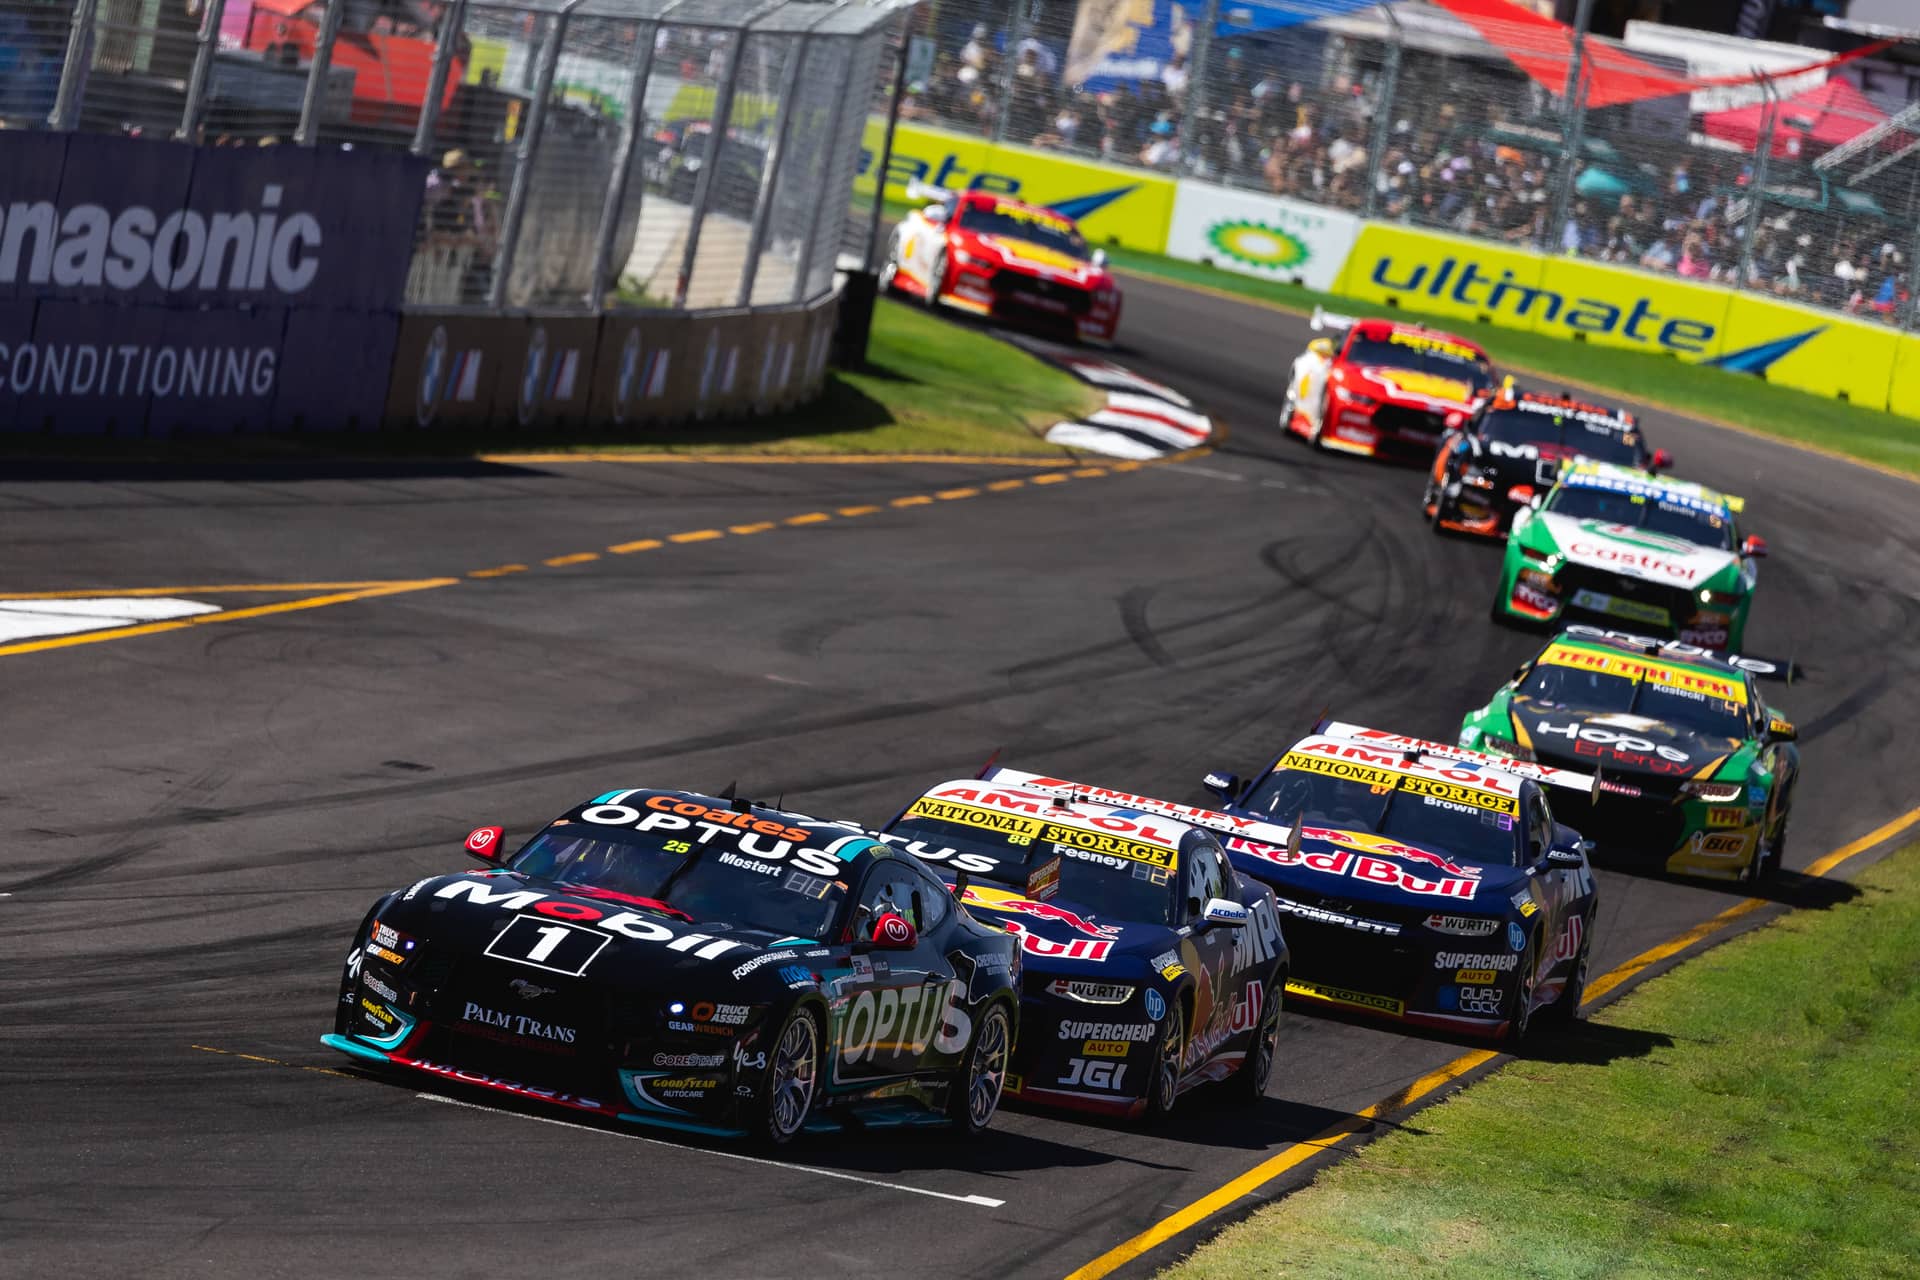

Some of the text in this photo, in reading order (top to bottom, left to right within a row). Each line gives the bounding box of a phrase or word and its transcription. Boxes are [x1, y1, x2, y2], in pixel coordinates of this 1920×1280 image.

[0, 184, 322, 292] nasonic
[1371, 256, 1715, 352] ultimate
[1570, 542, 1695, 580] Castrol
[1390, 734, 1560, 776] AMPLIFY
[1537, 721, 1689, 762] Hope
[1300, 742, 1514, 795] AMPOL
[1574, 738, 1695, 775] Energy
[1284, 753, 1392, 786] NATIONAL
[1403, 775, 1511, 813] STORAGE
[646, 795, 812, 842] coates
[935, 787, 1175, 845] AMPOL
[1066, 782, 1257, 829] AMPLIFY
[1424, 795, 1478, 816] Brown
[581, 804, 840, 876] OPTUS
[663, 839, 691, 854] 25
[912, 800, 1033, 835] NATIONAL
[1046, 826, 1168, 866] STORAGE
[1007, 834, 1031, 847] 88
[1705, 838, 1741, 852] BIC
[718, 851, 783, 877] Mostert
[1052, 843, 1129, 870] Feeney
[1354, 854, 1481, 900] Bull
[433, 880, 742, 960] Mobil
[1444, 916, 1495, 931] WÜRTH
[526, 926, 563, 962] 1
[1510, 928, 1524, 947] hp
[1435, 951, 1518, 972] SUPERCHEAP
[1460, 970, 1494, 982] AUTO
[1071, 982, 1126, 998] WÜRTH
[1461, 986, 1503, 1002] QUAD
[711, 1013, 749, 1025] ASSIST
[716, 1003, 750, 1015] TRUCK
[1149, 998, 1162, 1015] hp
[1458, 999, 1501, 1015] LOCK
[462, 1000, 511, 1029] PALM
[515, 1014, 576, 1044] TRANS
[843, 979, 972, 1065] OPTUS
[1058, 1019, 1156, 1043] SUPERCHEAP
[1088, 1042, 1124, 1054] AUTO
[653, 1077, 717, 1089] GOODYEAR
[1057, 1058, 1129, 1090] JGI
[663, 1089, 704, 1098] AUTOCARE
